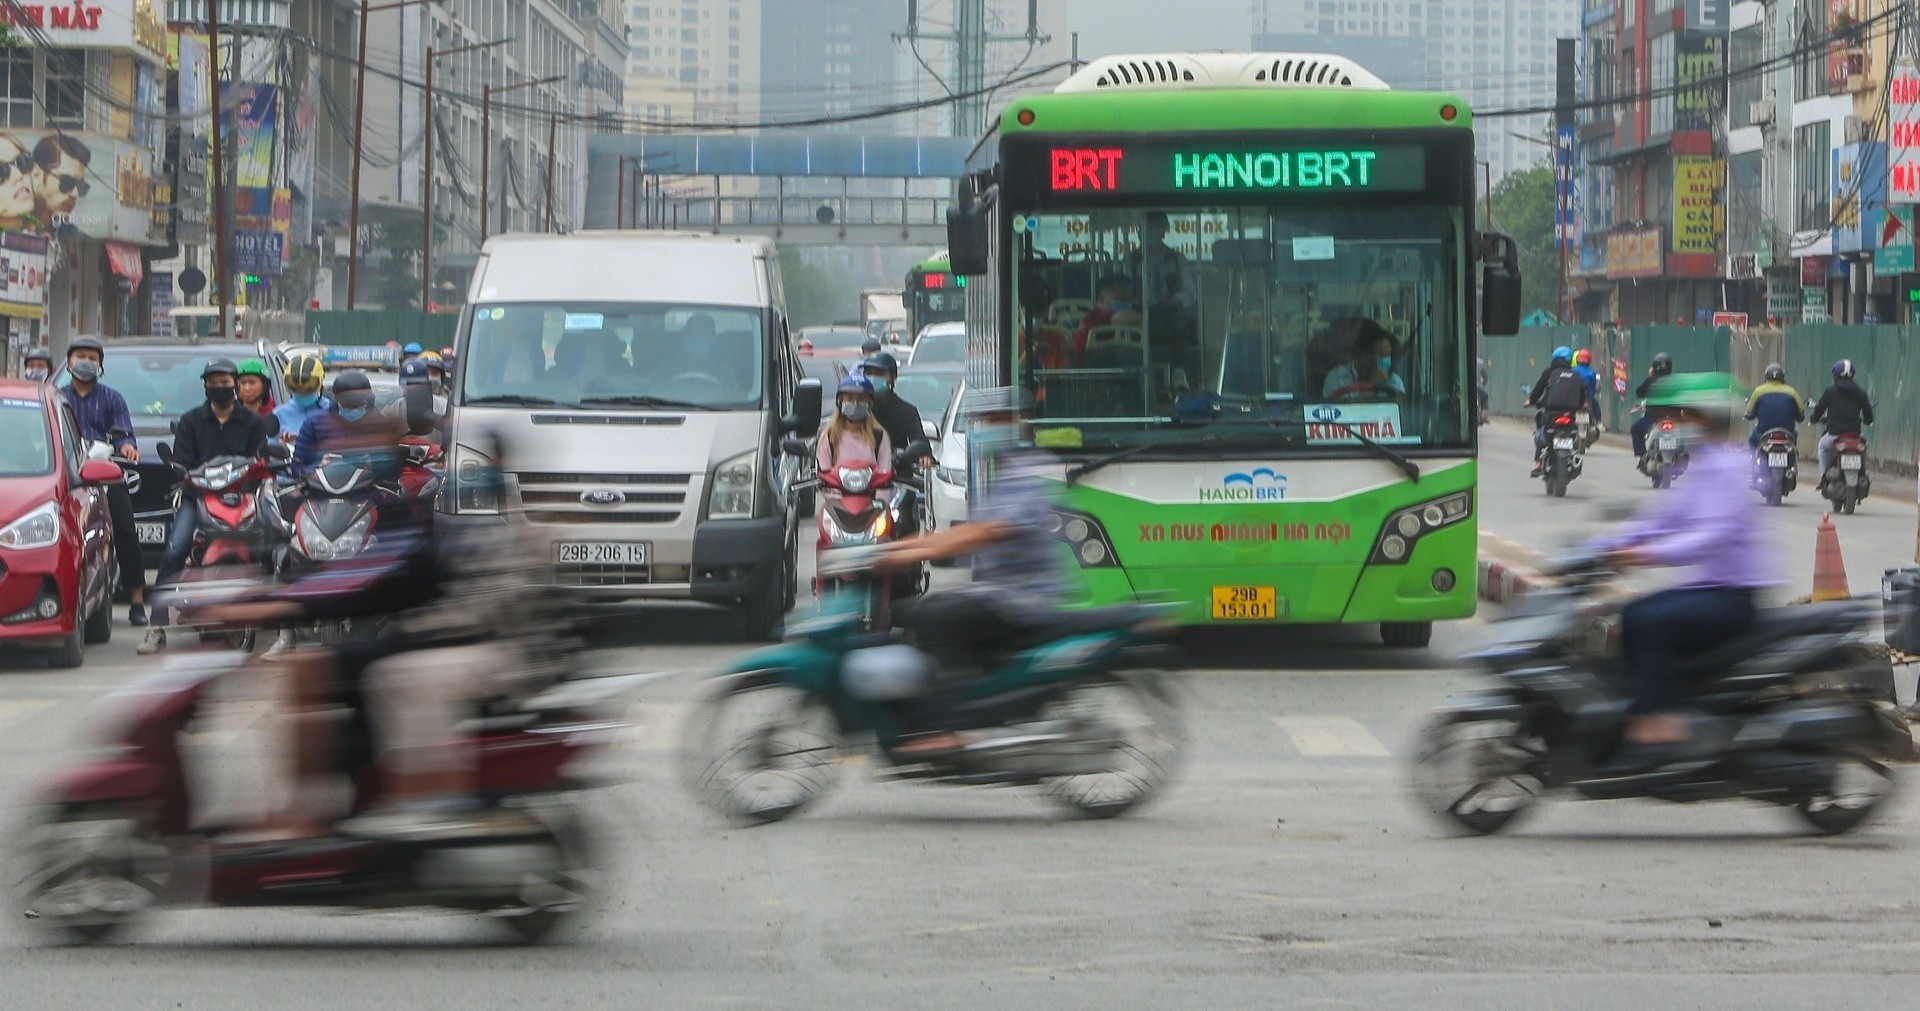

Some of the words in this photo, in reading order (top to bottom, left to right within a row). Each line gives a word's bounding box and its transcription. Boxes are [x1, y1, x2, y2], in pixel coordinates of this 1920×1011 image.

[1052, 149, 1122, 190] BRT
[1175, 152, 1290, 188] HANOI
[1297, 151, 1376, 187] BRT
[1308, 423, 1352, 440] KIM
[1170, 523, 1205, 543] BUS
[1230, 586, 1258, 602] 29B
